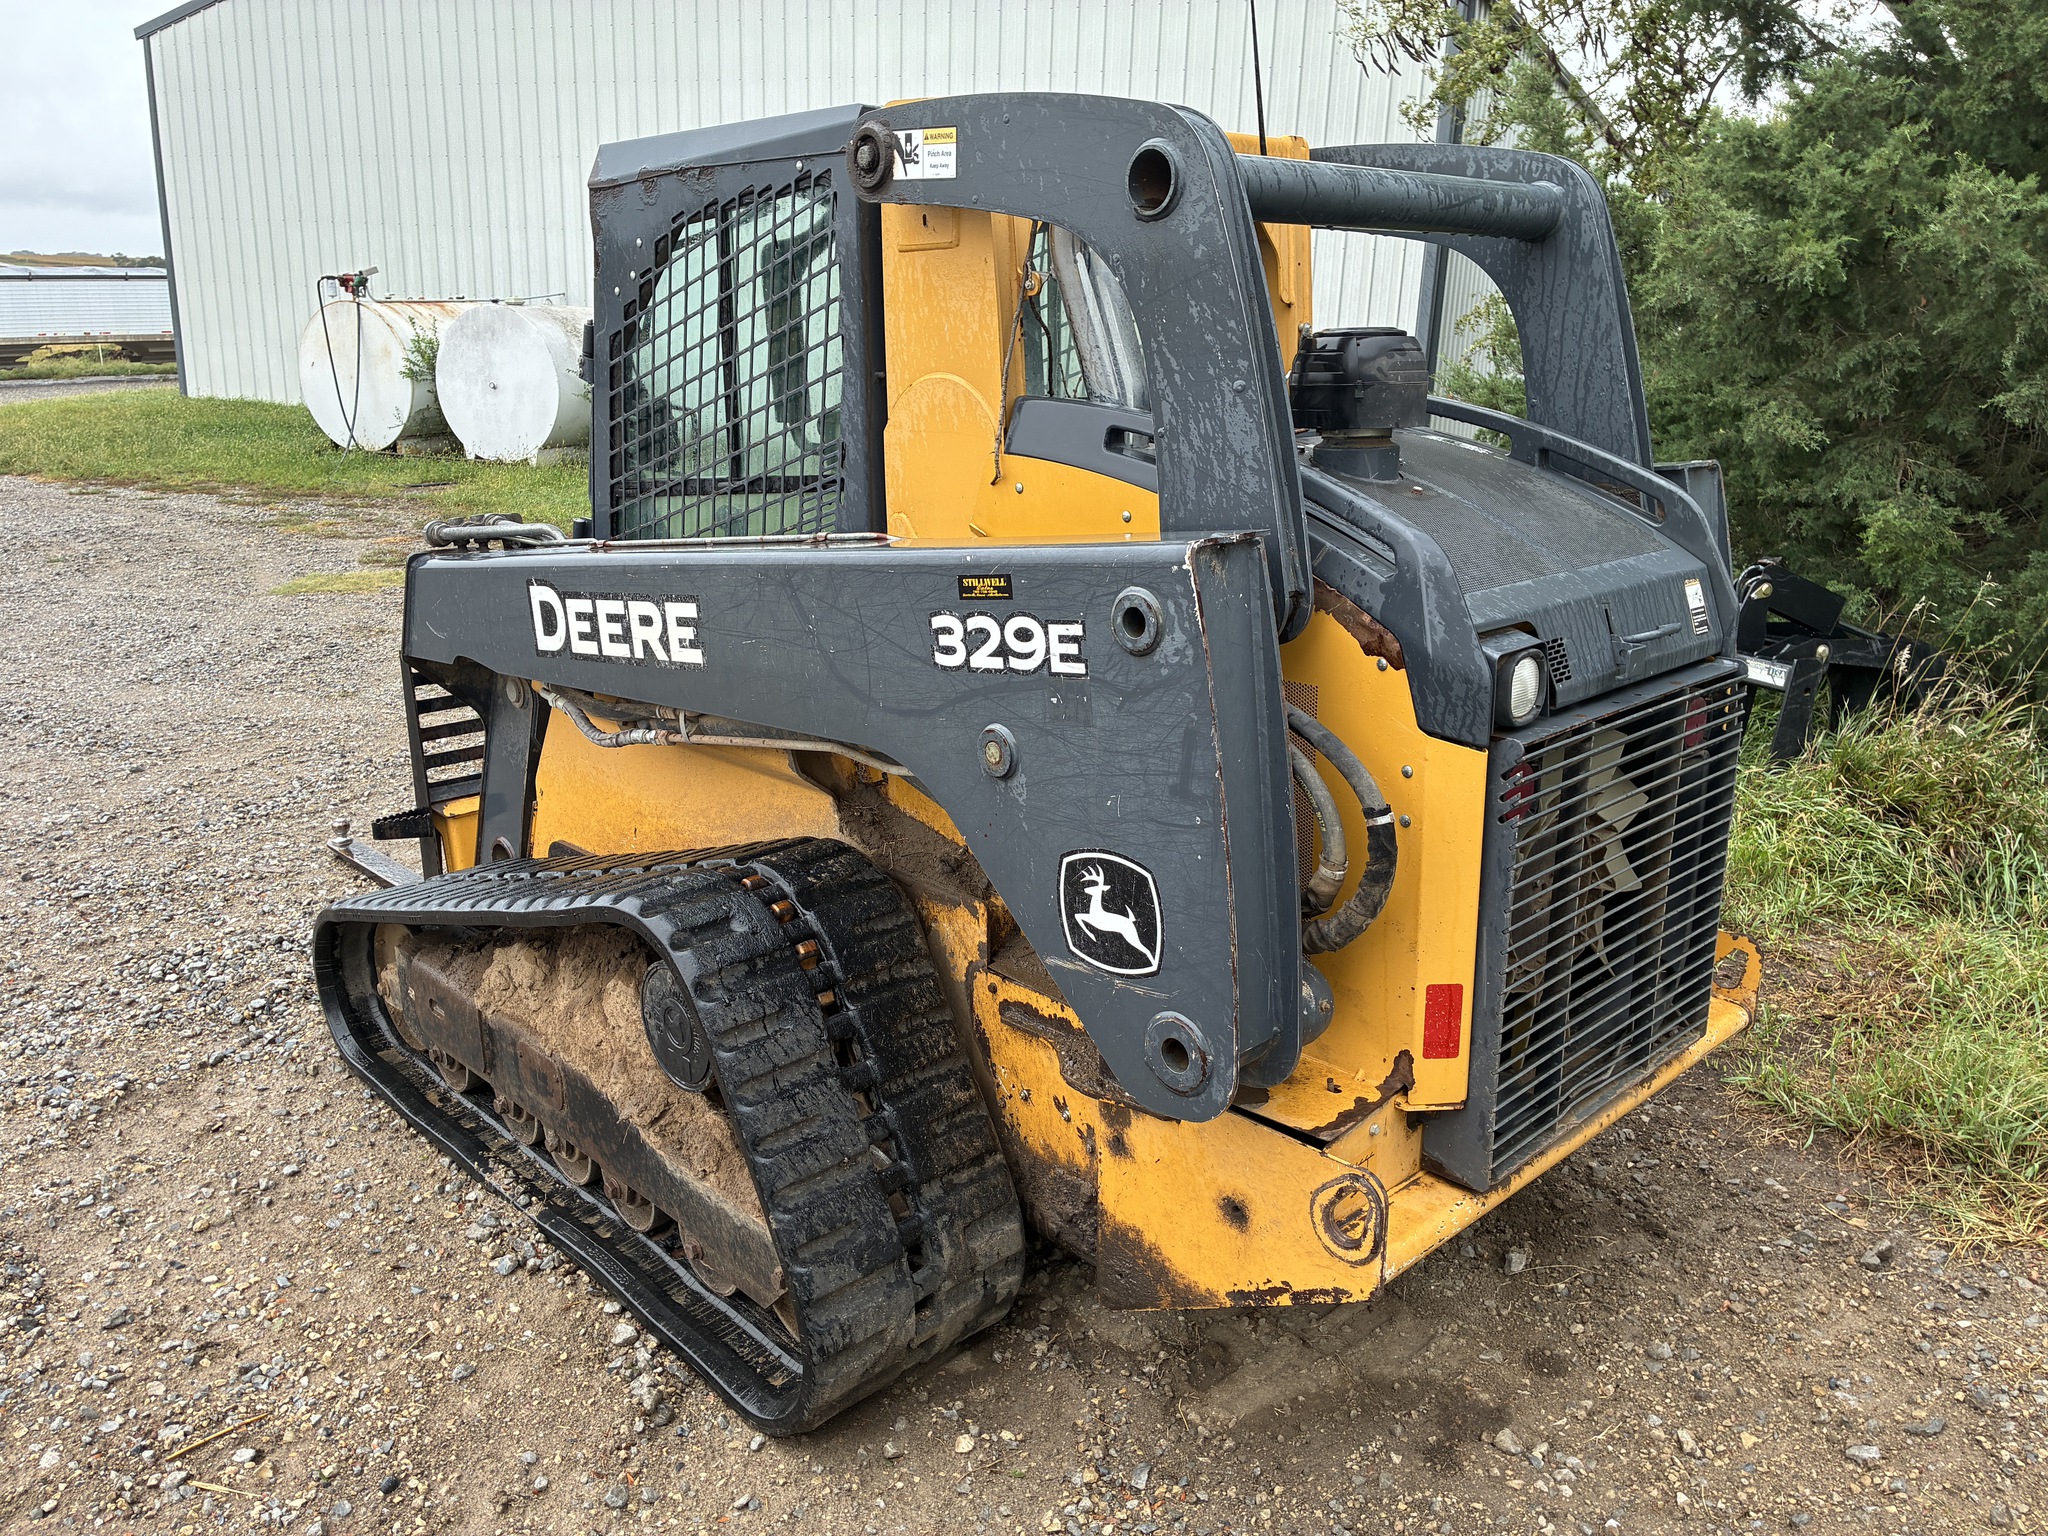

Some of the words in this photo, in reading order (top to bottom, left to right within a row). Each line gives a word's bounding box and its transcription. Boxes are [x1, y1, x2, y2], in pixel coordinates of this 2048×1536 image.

[929, 132, 954, 140] WARNING
[962, 578, 1007, 587] STILLWELL
[528, 585, 704, 666] DEERE
[930, 614, 1087, 674] 329E
